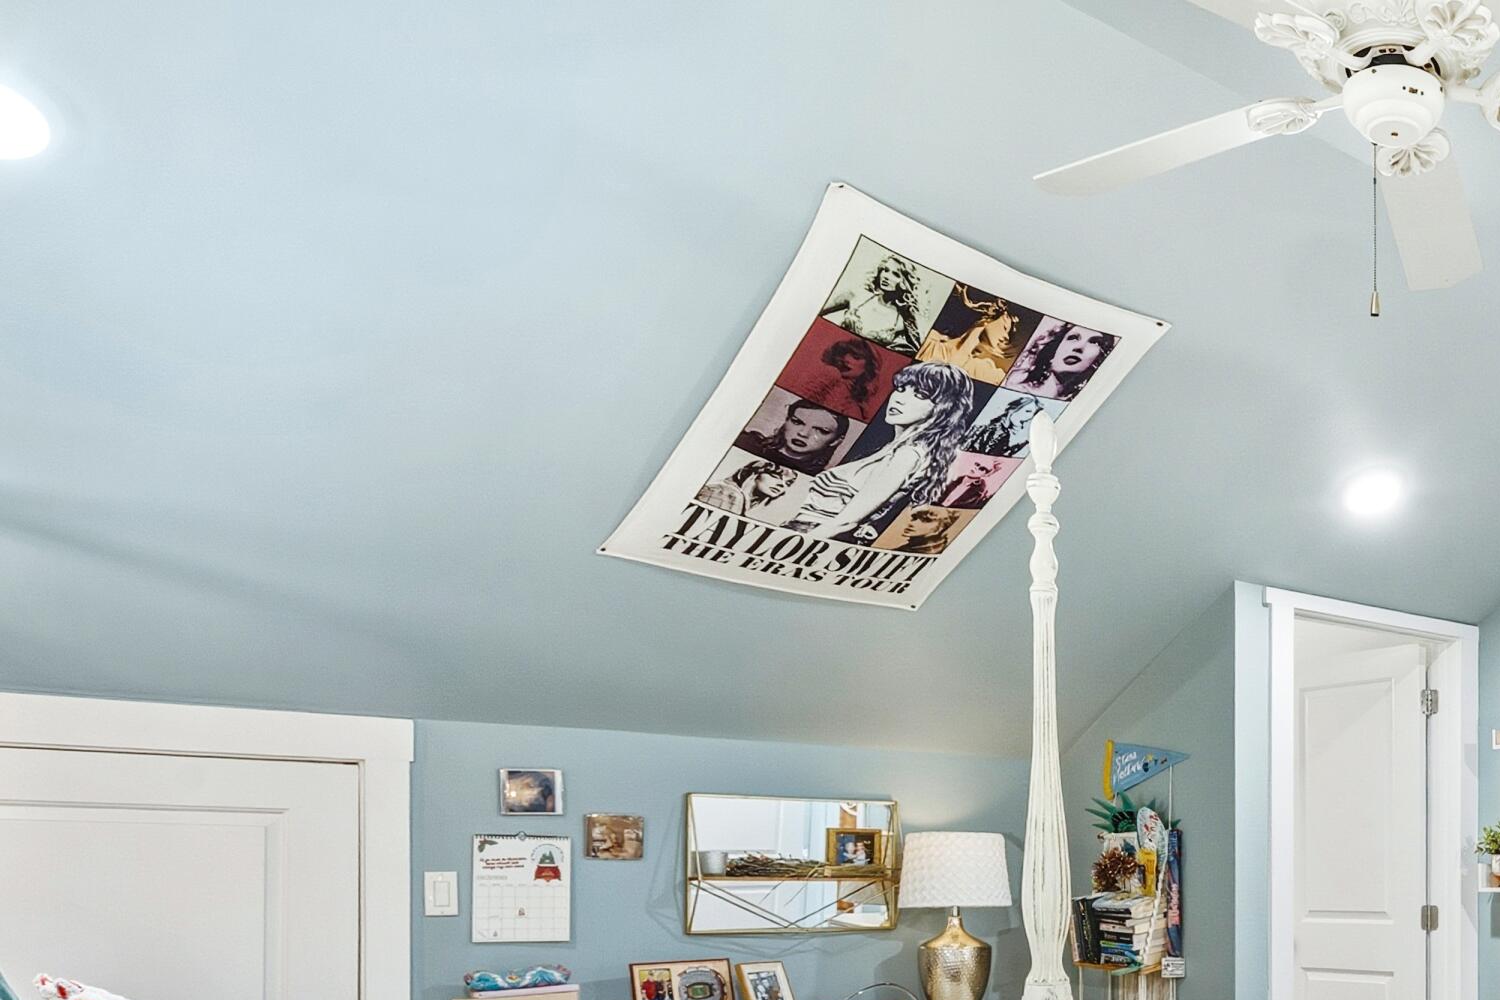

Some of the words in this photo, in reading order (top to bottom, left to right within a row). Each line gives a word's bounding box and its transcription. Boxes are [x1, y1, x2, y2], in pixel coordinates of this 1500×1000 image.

[660, 534, 736, 565] THE
[739, 556, 828, 583] ERAS
[833, 573, 912, 595] TOUR
[674, 502, 830, 567] TAYLOR
[827, 546, 938, 582] SWIFT
